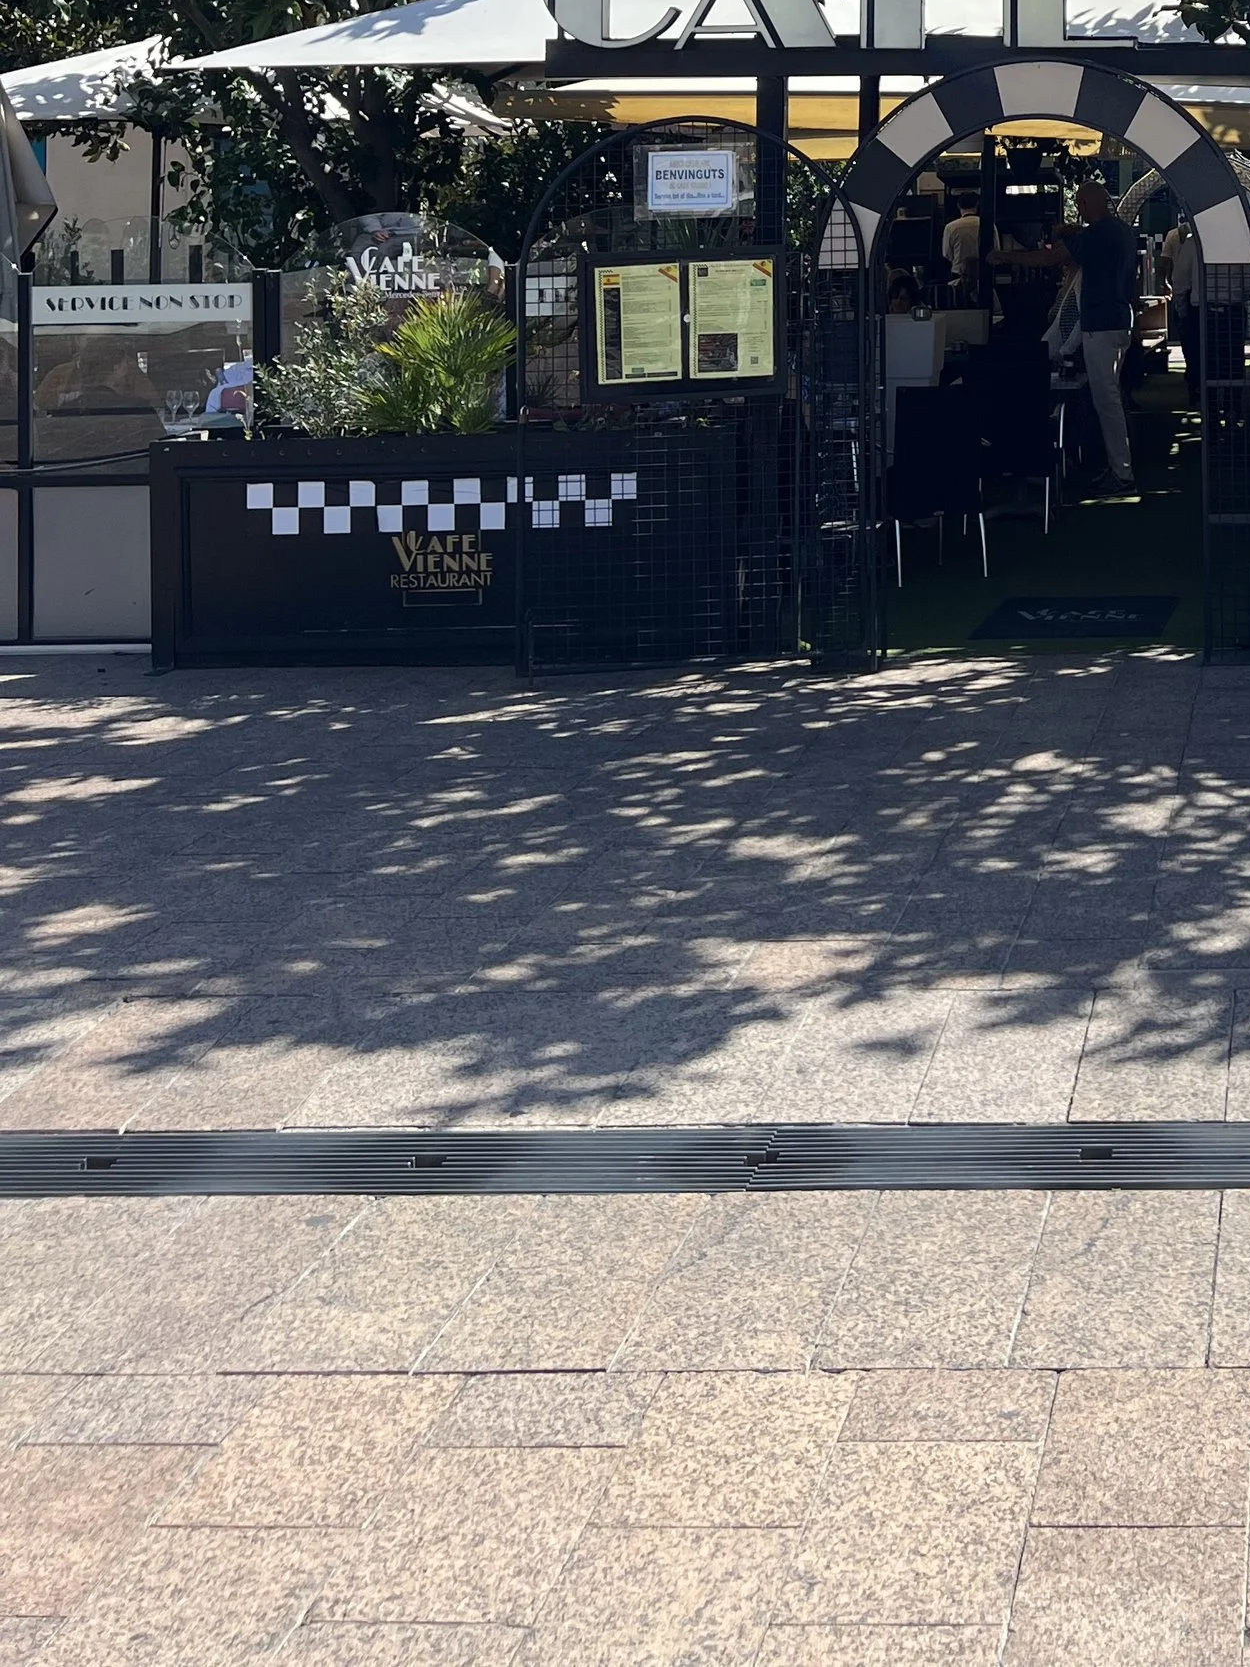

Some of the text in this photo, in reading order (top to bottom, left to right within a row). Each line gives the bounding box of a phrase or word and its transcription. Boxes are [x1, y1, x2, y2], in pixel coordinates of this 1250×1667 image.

[655, 168, 725, 181] BENVINGUTS
[361, 246, 425, 273] CAFE
[345, 255, 441, 291] VIENNE
[45, 294, 243, 312] SERVICE NON STOP
[391, 536, 494, 572] VIENNE
[406, 530, 476, 554] CAFE
[390, 572, 494, 589] RESTAURANT
